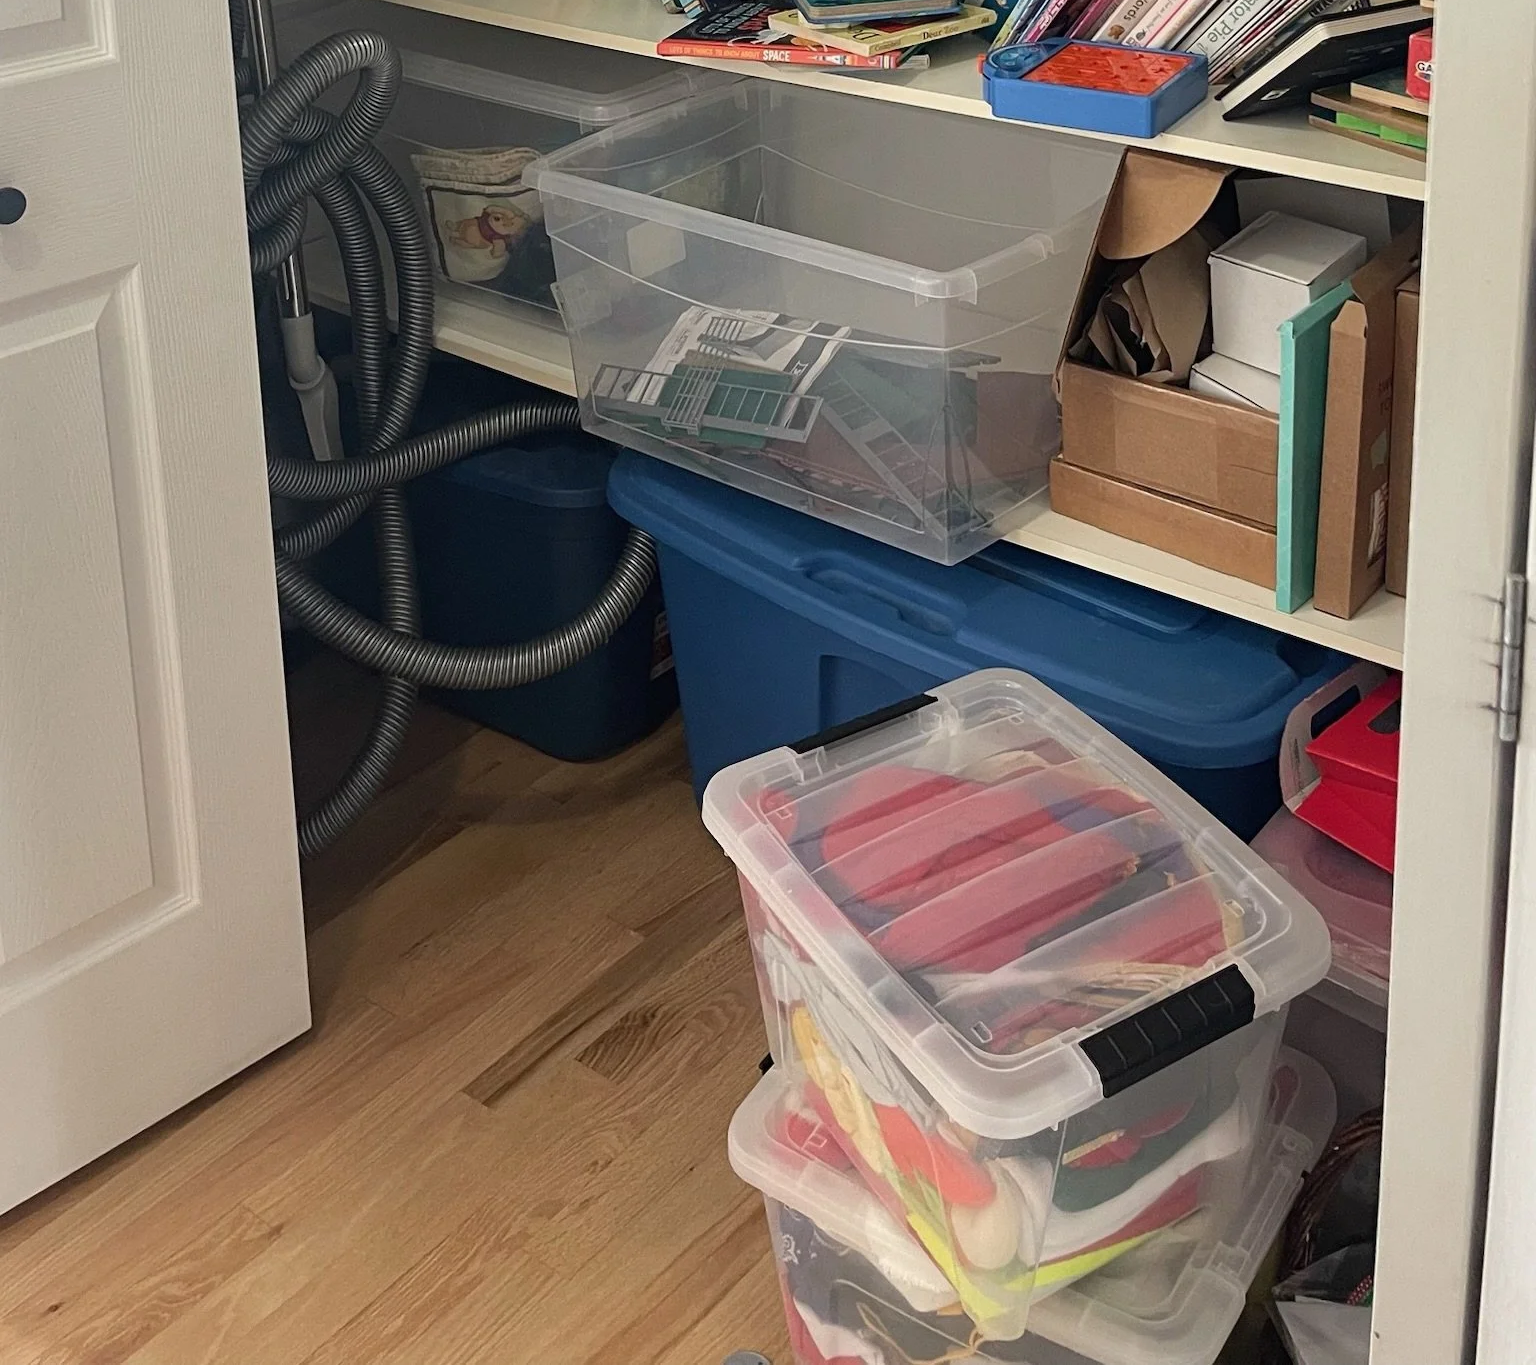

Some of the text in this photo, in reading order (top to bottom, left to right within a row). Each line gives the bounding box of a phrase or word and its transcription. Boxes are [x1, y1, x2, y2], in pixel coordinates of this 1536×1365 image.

[922, 30, 942, 40] Dear
[1205, 18, 1234, 47] Pie
[763, 50, 791, 62] SPACE
[1416, 62, 1434, 72] GA
